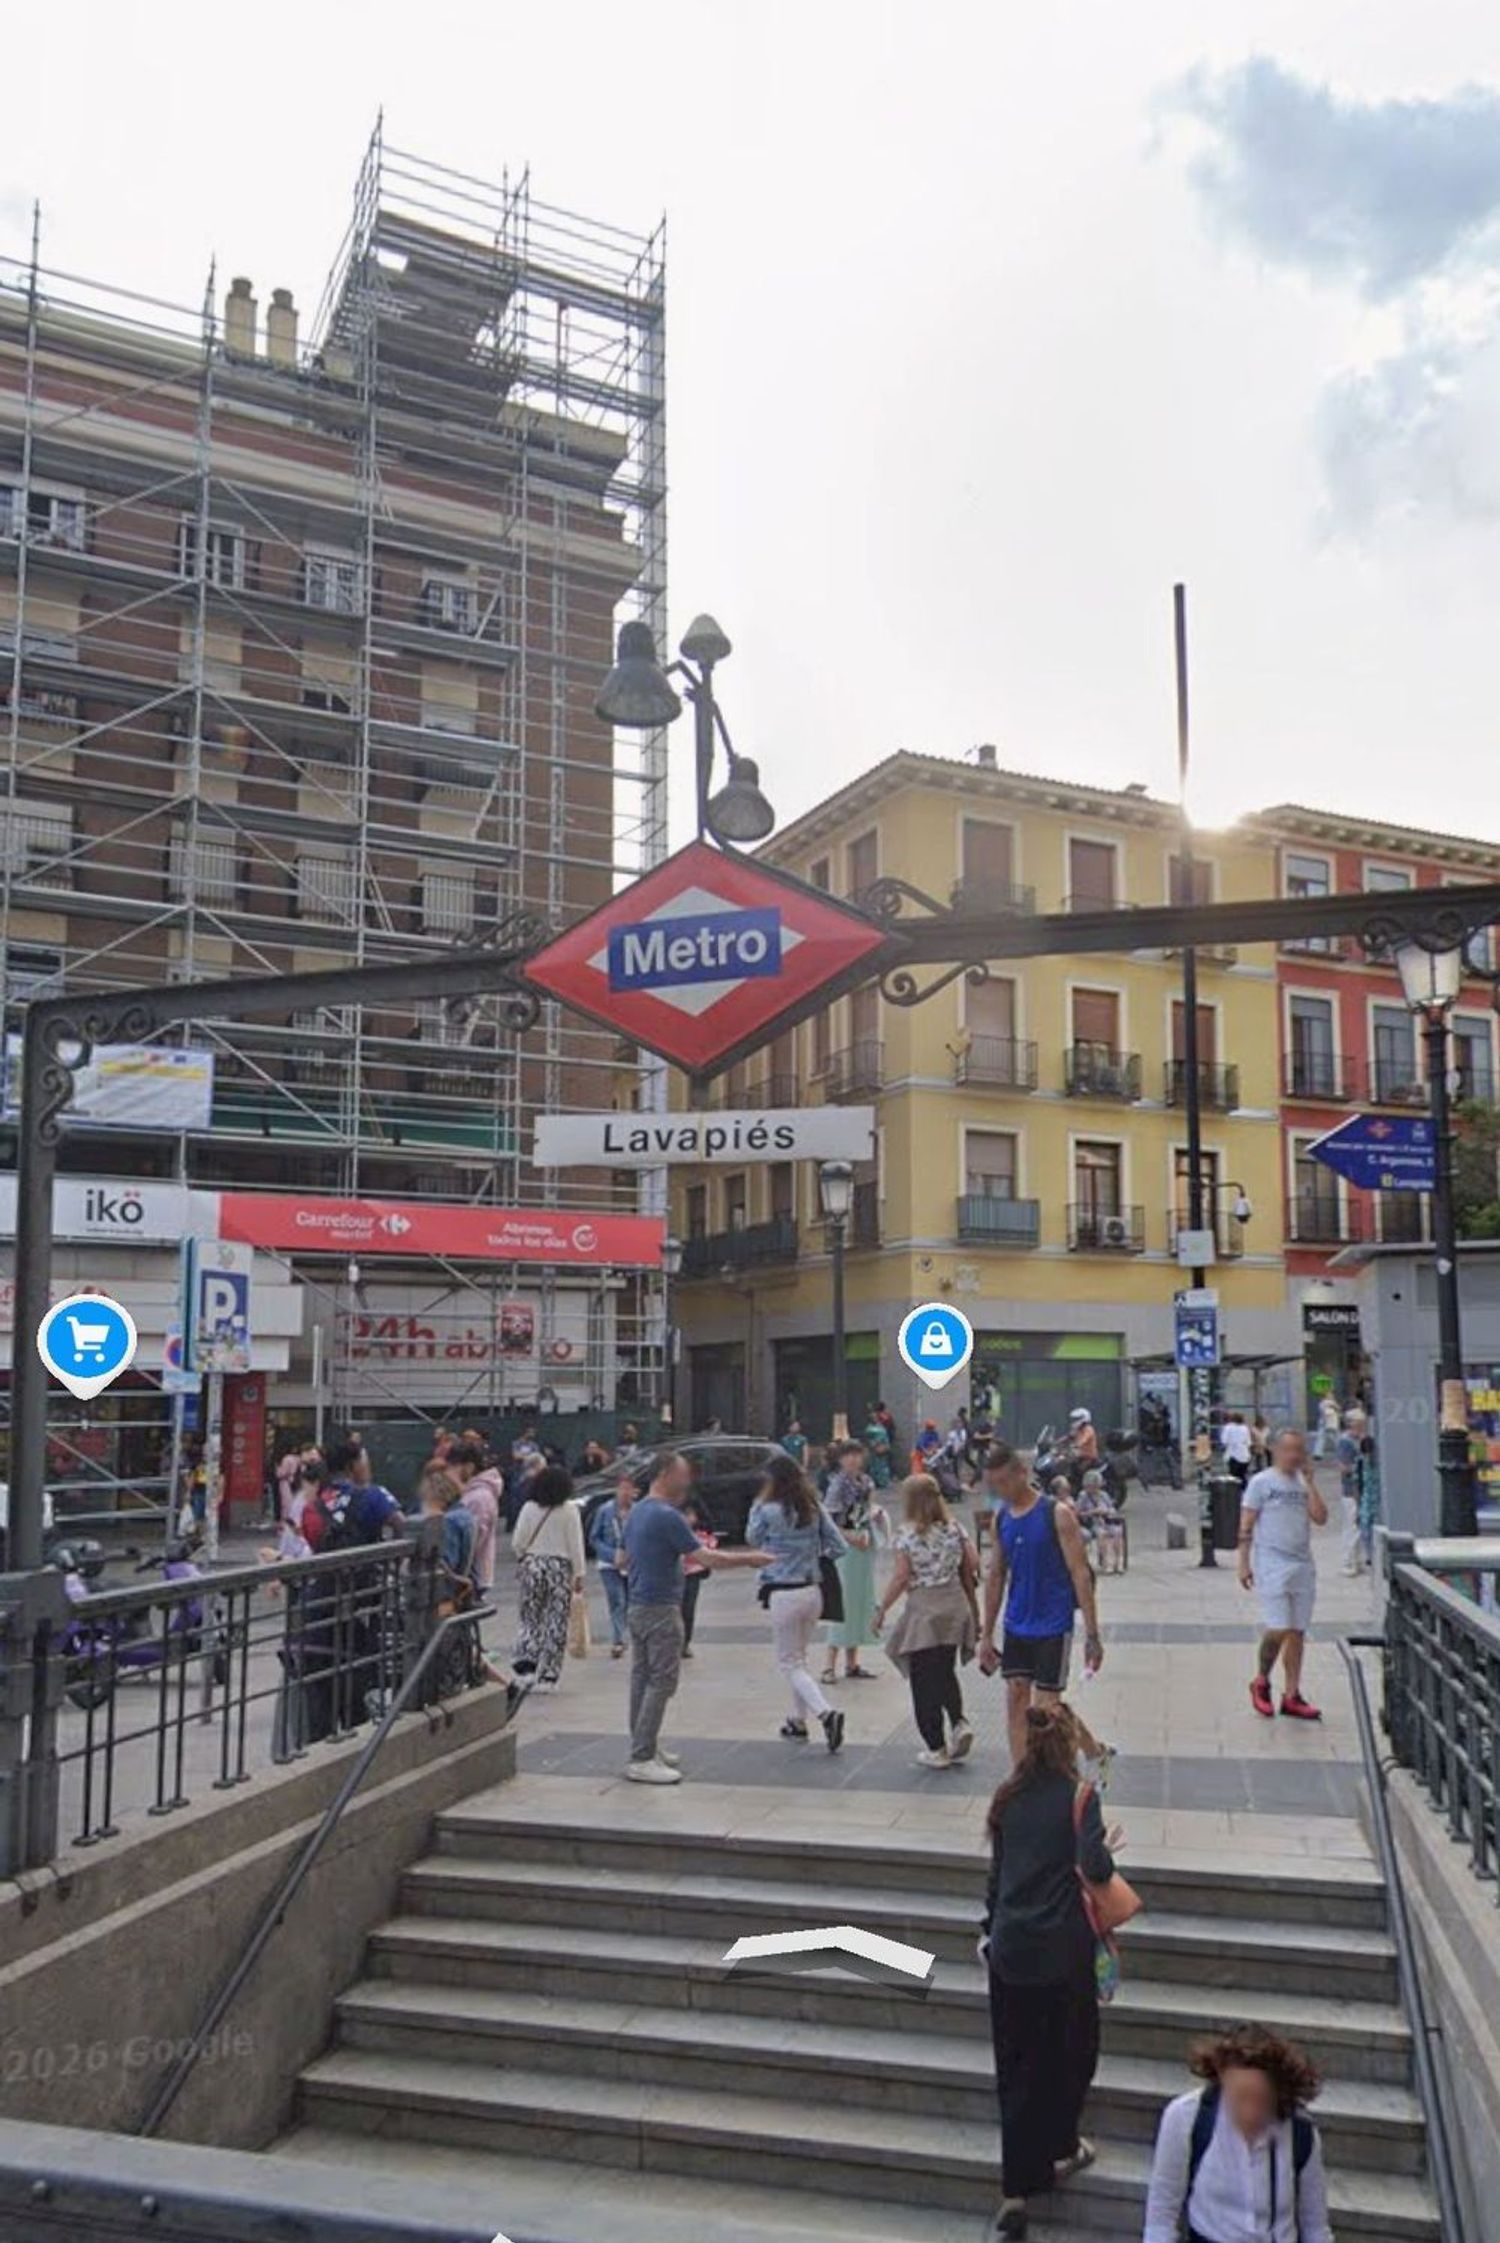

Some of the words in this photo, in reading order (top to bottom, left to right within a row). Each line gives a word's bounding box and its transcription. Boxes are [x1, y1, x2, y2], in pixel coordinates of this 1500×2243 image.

[623, 927, 767, 976] Metro
[603, 1119, 795, 1157] Lavapiés
[86, 1189, 143, 1223] ikö
